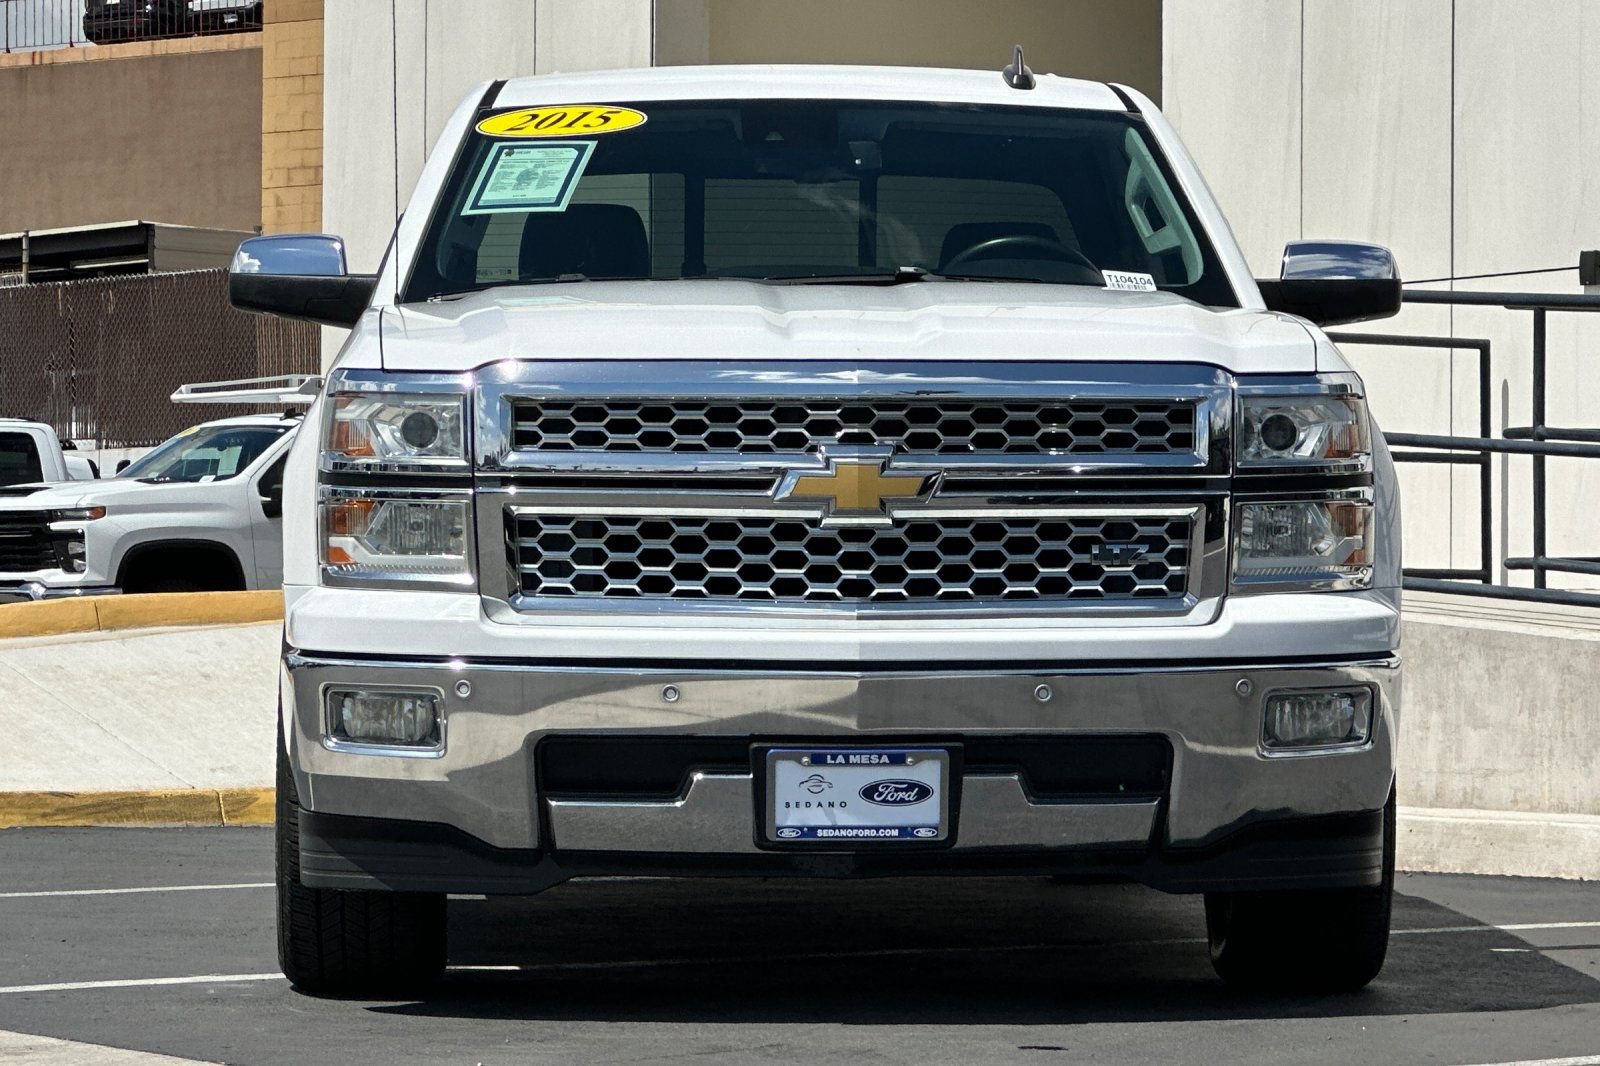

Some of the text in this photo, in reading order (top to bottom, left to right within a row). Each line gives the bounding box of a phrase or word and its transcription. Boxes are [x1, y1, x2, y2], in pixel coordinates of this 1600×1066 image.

[504, 110, 622, 132] 2015
[1106, 274, 1153, 286] T104104
[1091, 544, 1150, 566] LTZ
[827, 755, 890, 764] LA MESA
[873, 783, 918, 802] Ford
[785, 801, 848, 809] SEDANO
[817, 829, 899, 837] SEDANOFORD.COM
